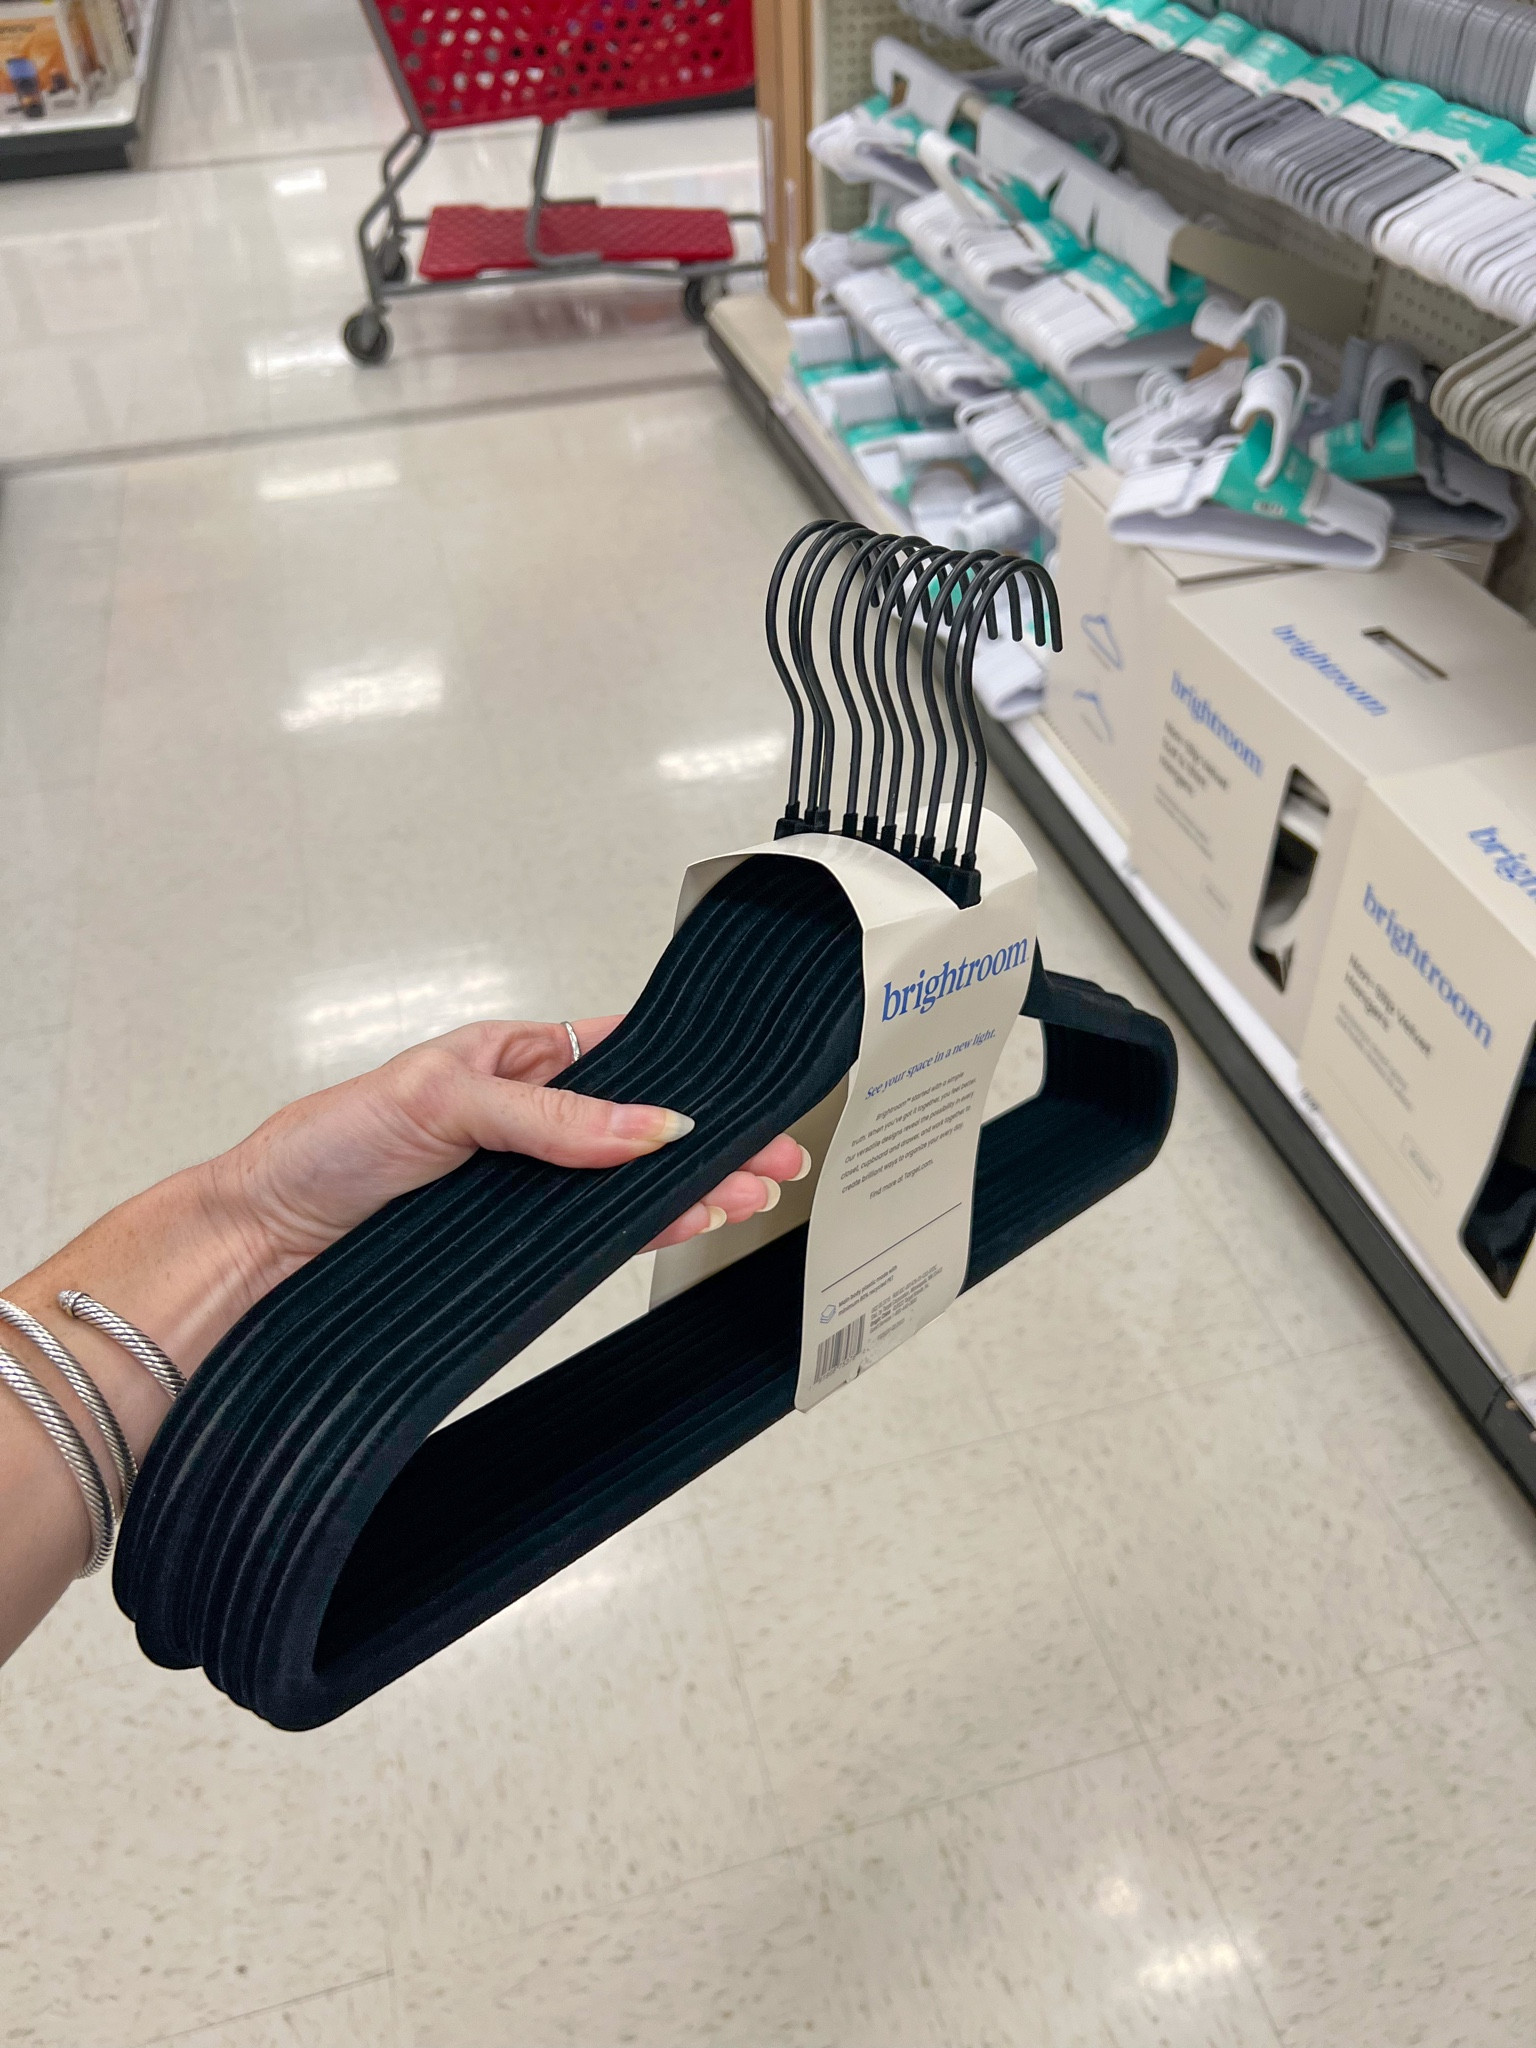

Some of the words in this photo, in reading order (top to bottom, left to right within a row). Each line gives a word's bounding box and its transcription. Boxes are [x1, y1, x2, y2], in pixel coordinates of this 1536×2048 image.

[1171, 669, 1264, 779] brightroom
[882, 938, 1028, 1022] brightroom
[1362, 881, 1494, 1049] brightroom
[865, 1082, 883, 1100] See
[881, 1070, 906, 1093] your
[906, 1057, 933, 1078] space
[934, 1051, 944, 1063] in
[945, 1049, 951, 1059] a
[952, 1039, 973, 1055] new
[972, 1028, 996, 1046] light.
